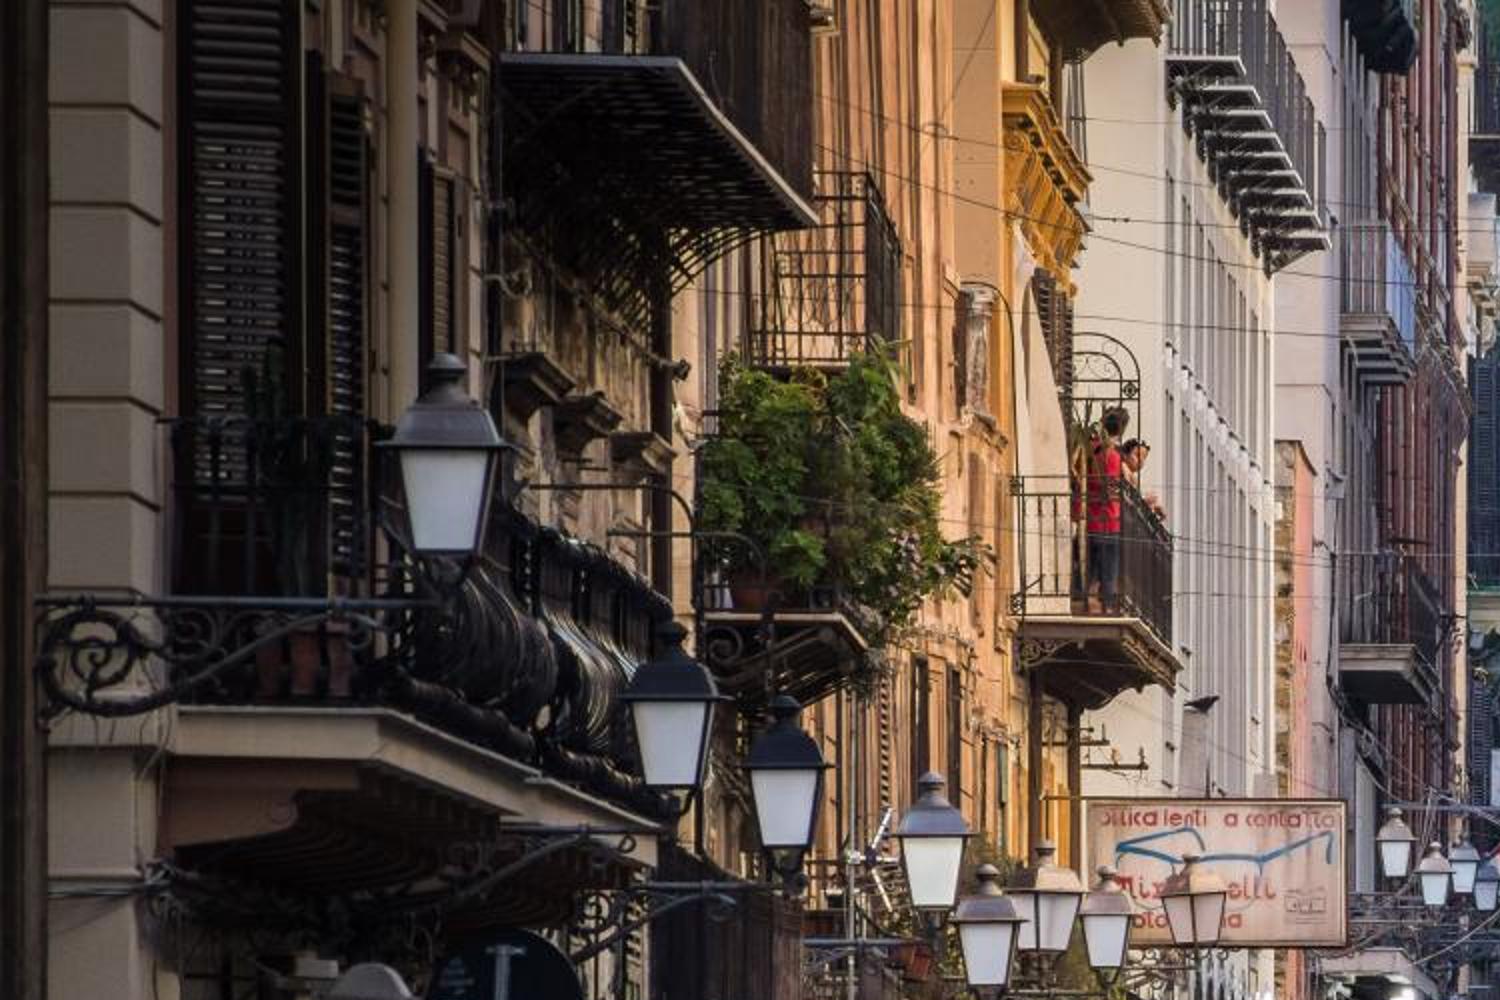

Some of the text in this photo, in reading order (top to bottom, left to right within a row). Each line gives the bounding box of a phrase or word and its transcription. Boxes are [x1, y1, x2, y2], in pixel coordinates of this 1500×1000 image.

[1163, 808, 1207, 828] lenti
[1224, 812, 1238, 828] a
[1246, 808, 1335, 828] contatto
